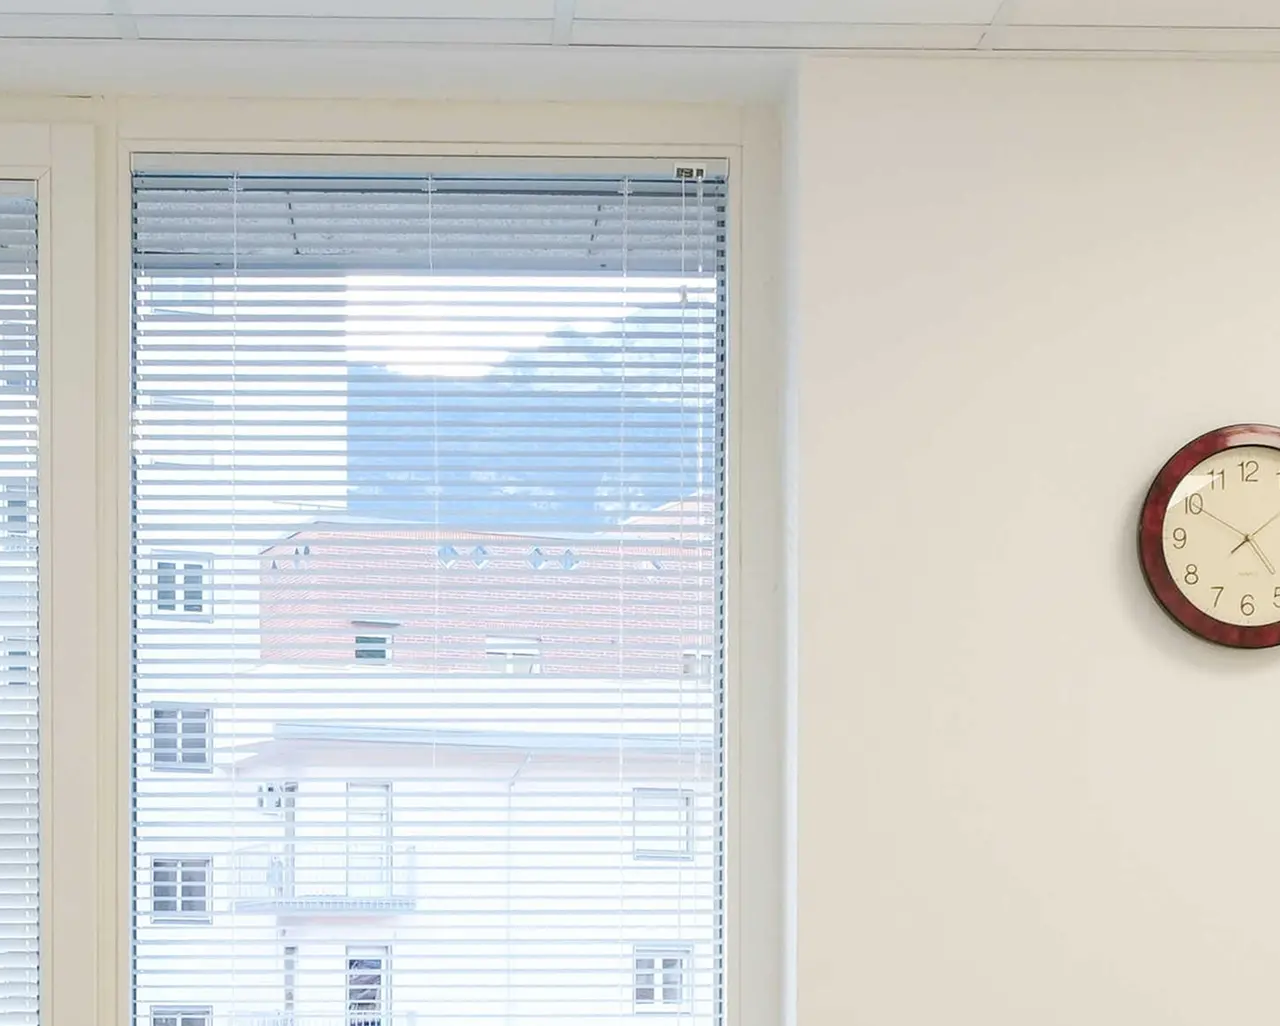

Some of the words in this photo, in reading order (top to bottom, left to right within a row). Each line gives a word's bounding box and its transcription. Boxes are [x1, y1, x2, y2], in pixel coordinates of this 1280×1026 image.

[1207, 470, 1225, 490] 11
[1238, 461, 1259, 482] 12
[1185, 493, 1203, 514] 10
[1173, 528, 1187, 549] 9
[1184, 564, 1199, 585] 8
[1211, 586, 1224, 607] 7
[1240, 594, 1255, 616] 6
